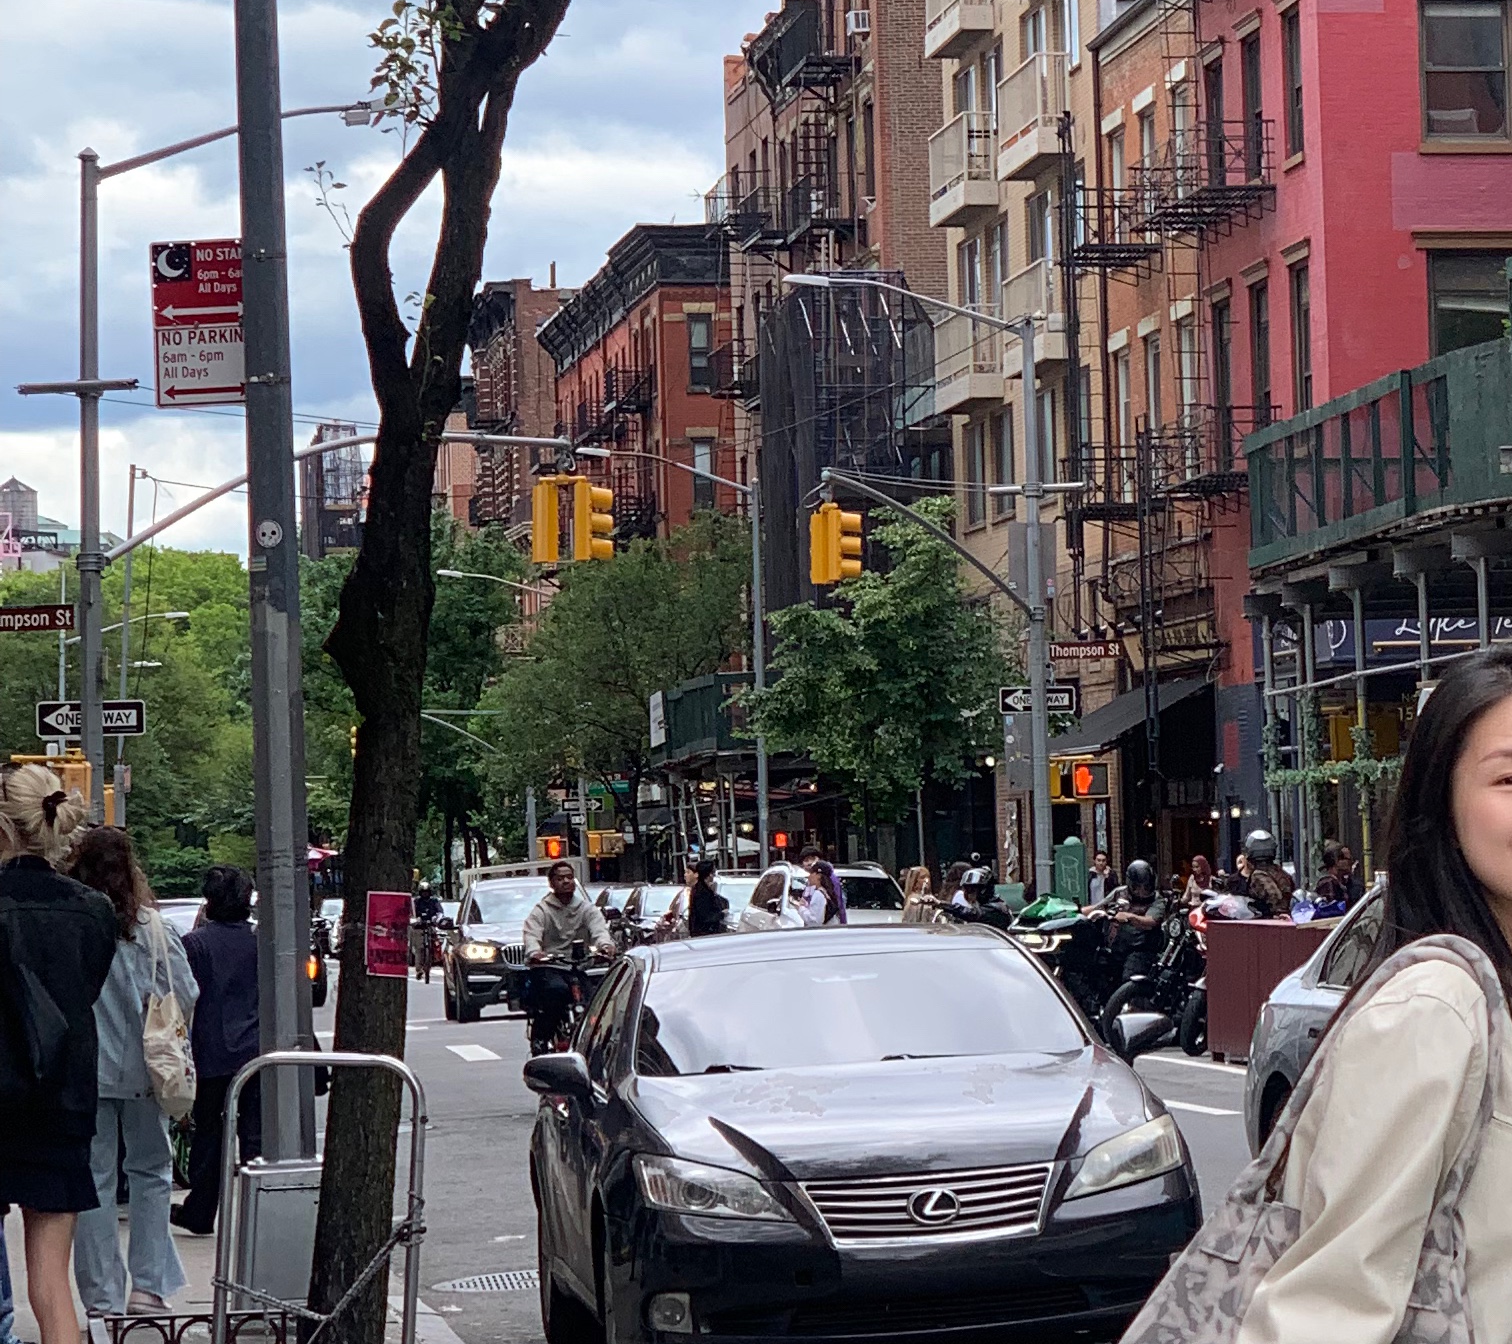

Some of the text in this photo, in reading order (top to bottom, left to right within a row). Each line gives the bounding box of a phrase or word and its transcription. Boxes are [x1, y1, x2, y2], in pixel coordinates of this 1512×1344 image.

[196, 248, 213, 262] NO
[197, 269, 219, 281] 6pm
[228, 267, 243, 279] 6a
[198, 282, 237, 295] All Days
[161, 330, 183, 347] NO
[163, 351, 187, 364] 6am
[199, 349, 224, 363] 6pm
[163, 365, 209, 381] All Days
[55, 609, 71, 626] St
[1050, 642, 1120, 659] Thompson St
[1012, 695, 1032, 705] ONE
[55, 710, 132, 725] ONE WAY
